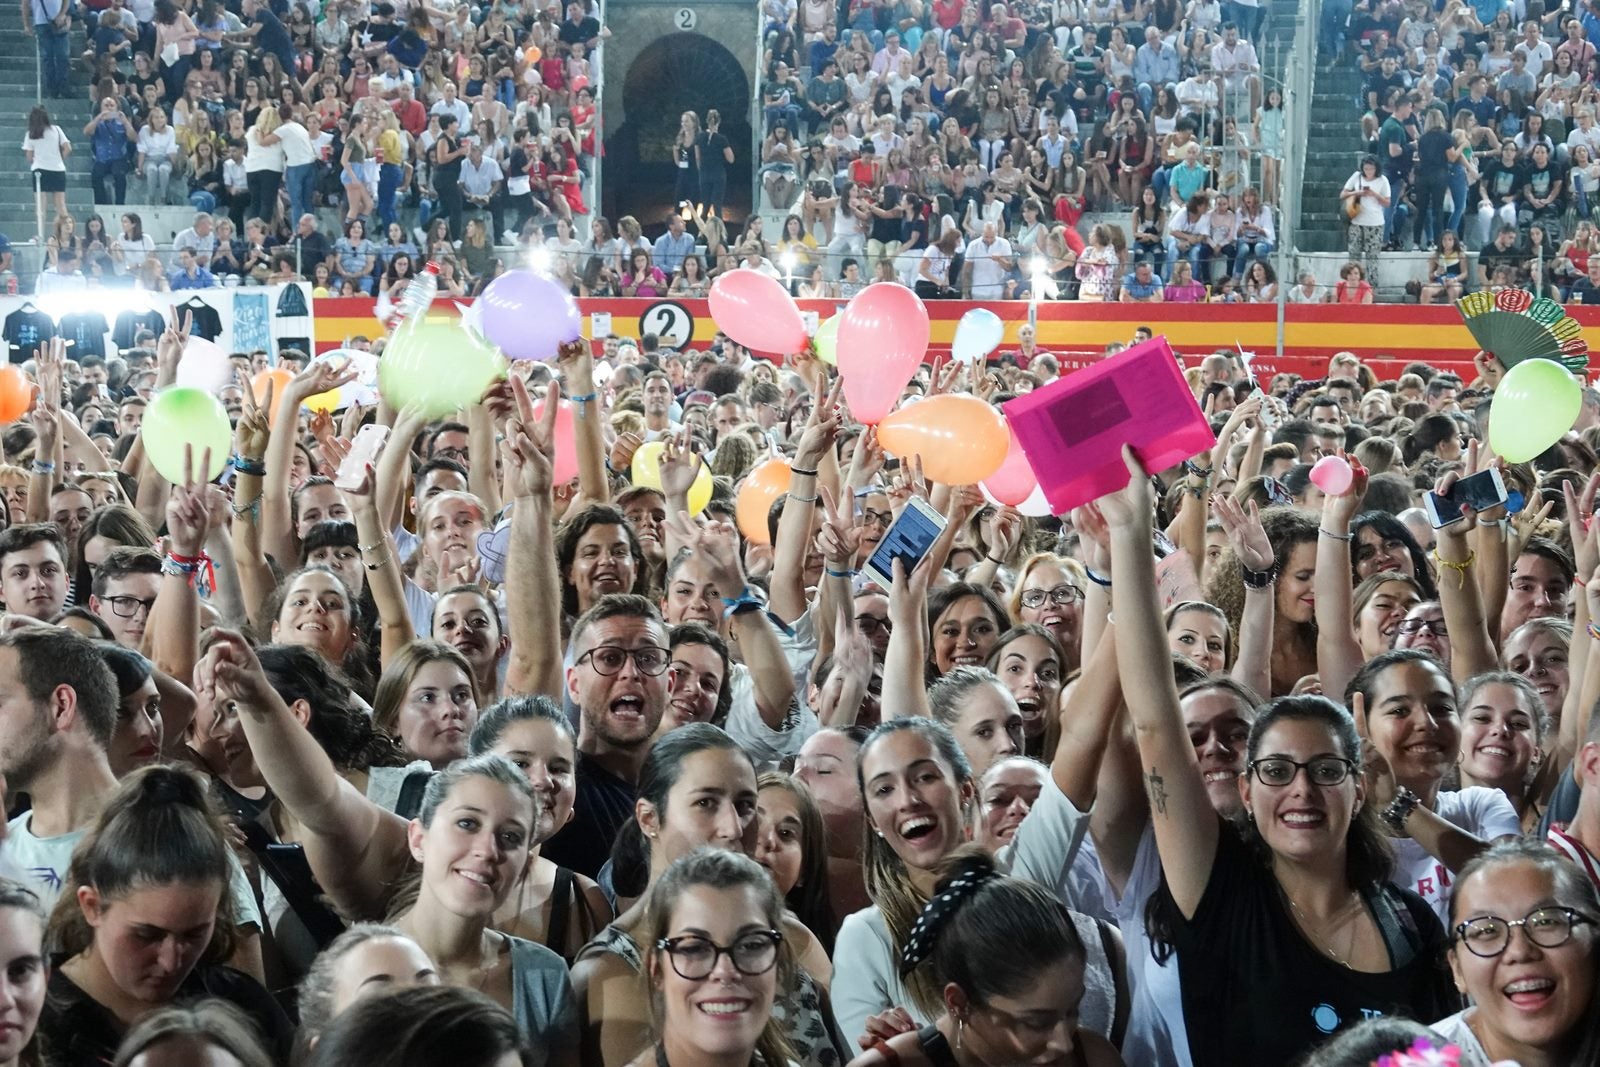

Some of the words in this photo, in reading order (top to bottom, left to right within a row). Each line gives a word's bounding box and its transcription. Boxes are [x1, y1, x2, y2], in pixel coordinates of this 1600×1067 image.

[680, 9, 692, 28] 2
[656, 308, 676, 337] 2
[1250, 364, 1277, 373] ENSA
